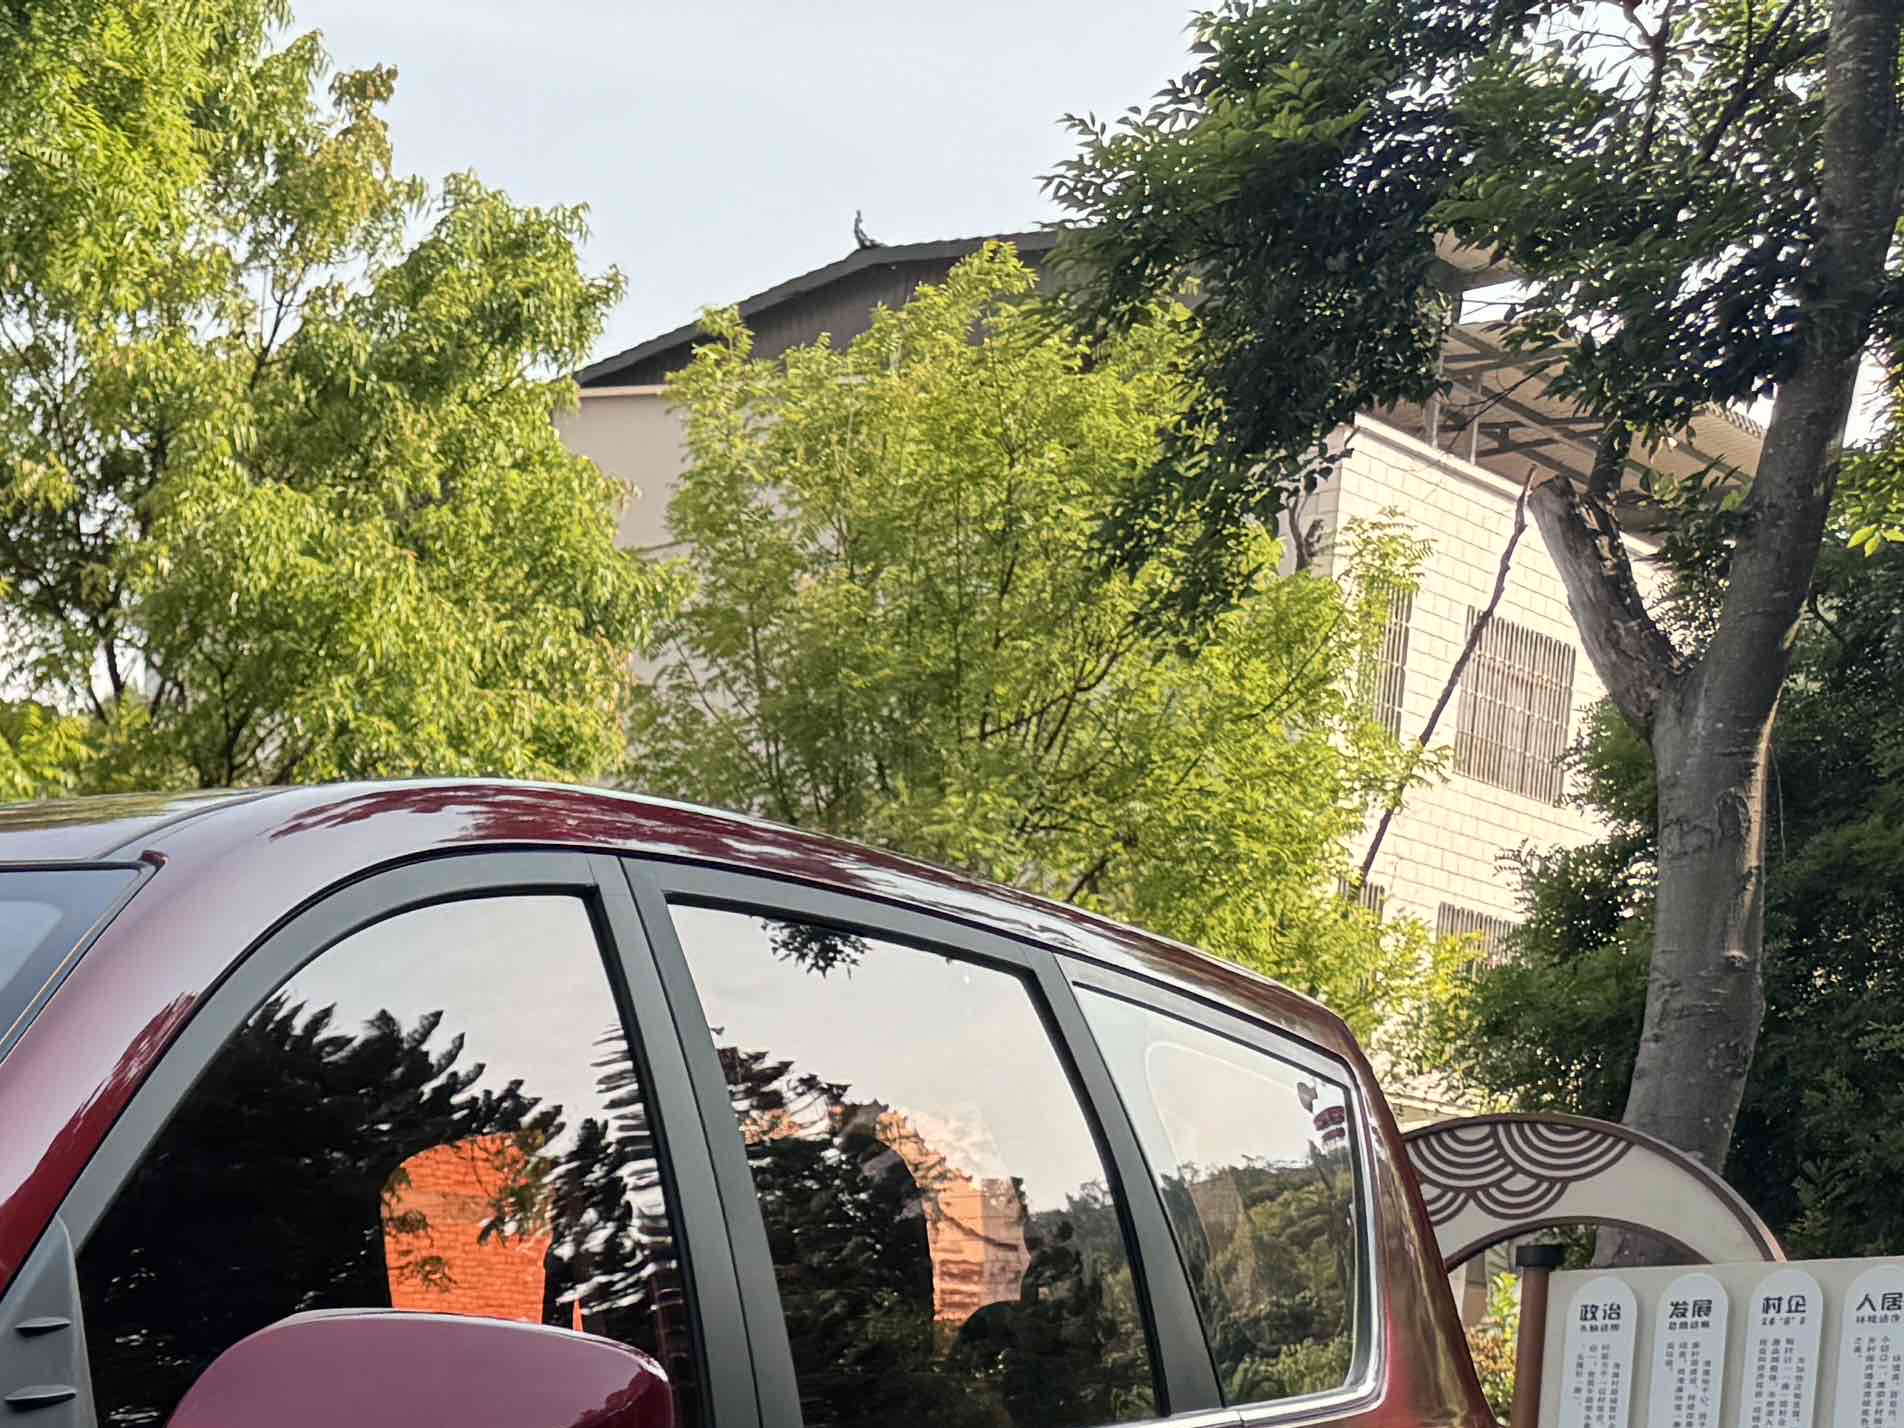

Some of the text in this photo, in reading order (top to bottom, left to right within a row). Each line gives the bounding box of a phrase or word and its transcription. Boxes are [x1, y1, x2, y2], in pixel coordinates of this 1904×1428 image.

[1668, 1299, 1714, 1319] 发展
[1761, 1294, 1807, 1315] 村企
[1855, 1291, 1904, 1313] 人居
[1578, 1303, 1622, 1322] 政治
